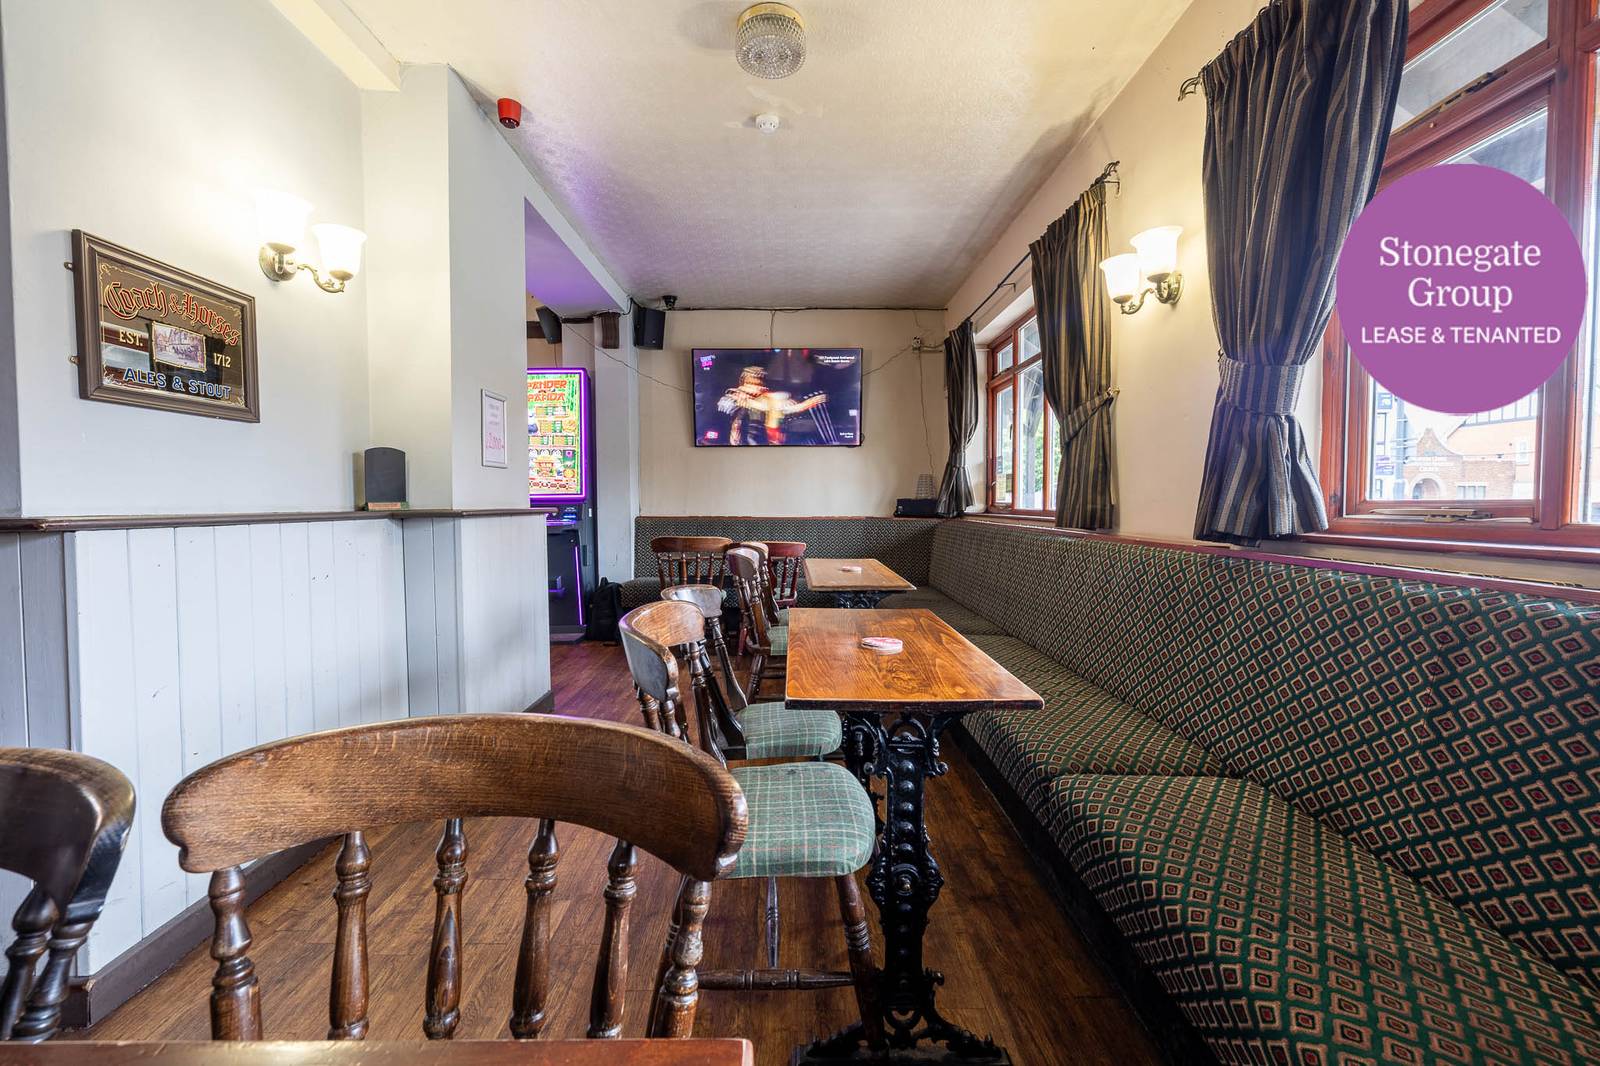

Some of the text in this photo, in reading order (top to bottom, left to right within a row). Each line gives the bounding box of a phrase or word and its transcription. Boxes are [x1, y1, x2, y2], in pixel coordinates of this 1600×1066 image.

[105, 281, 241, 347] Coach & Horses
[119, 328, 143, 347] EST.
[213, 352, 231, 368] 1712
[123, 367, 232, 399] ALES & STOUT
